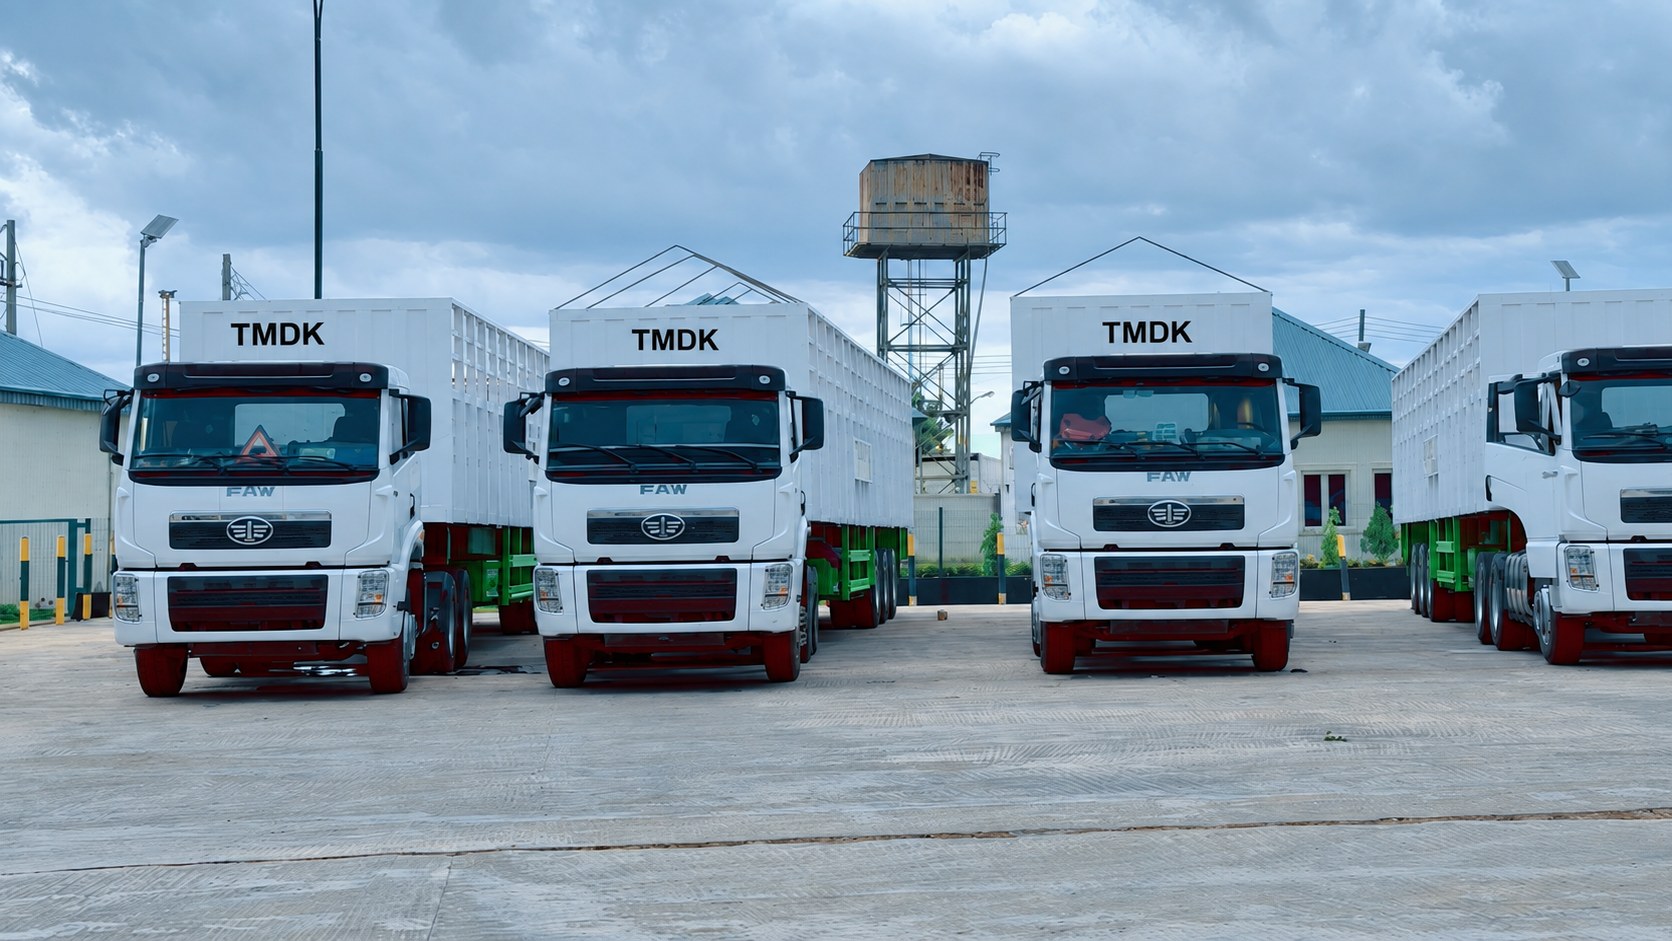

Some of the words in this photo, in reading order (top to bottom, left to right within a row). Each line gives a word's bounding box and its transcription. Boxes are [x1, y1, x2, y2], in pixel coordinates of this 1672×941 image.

[231, 322, 325, 347] TMDK
[632, 328, 719, 351] TMDK
[1102, 320, 1192, 343] TMDK
[1147, 471, 1191, 482] FAW
[226, 486, 275, 497] FAW
[640, 484, 687, 495] FAW
